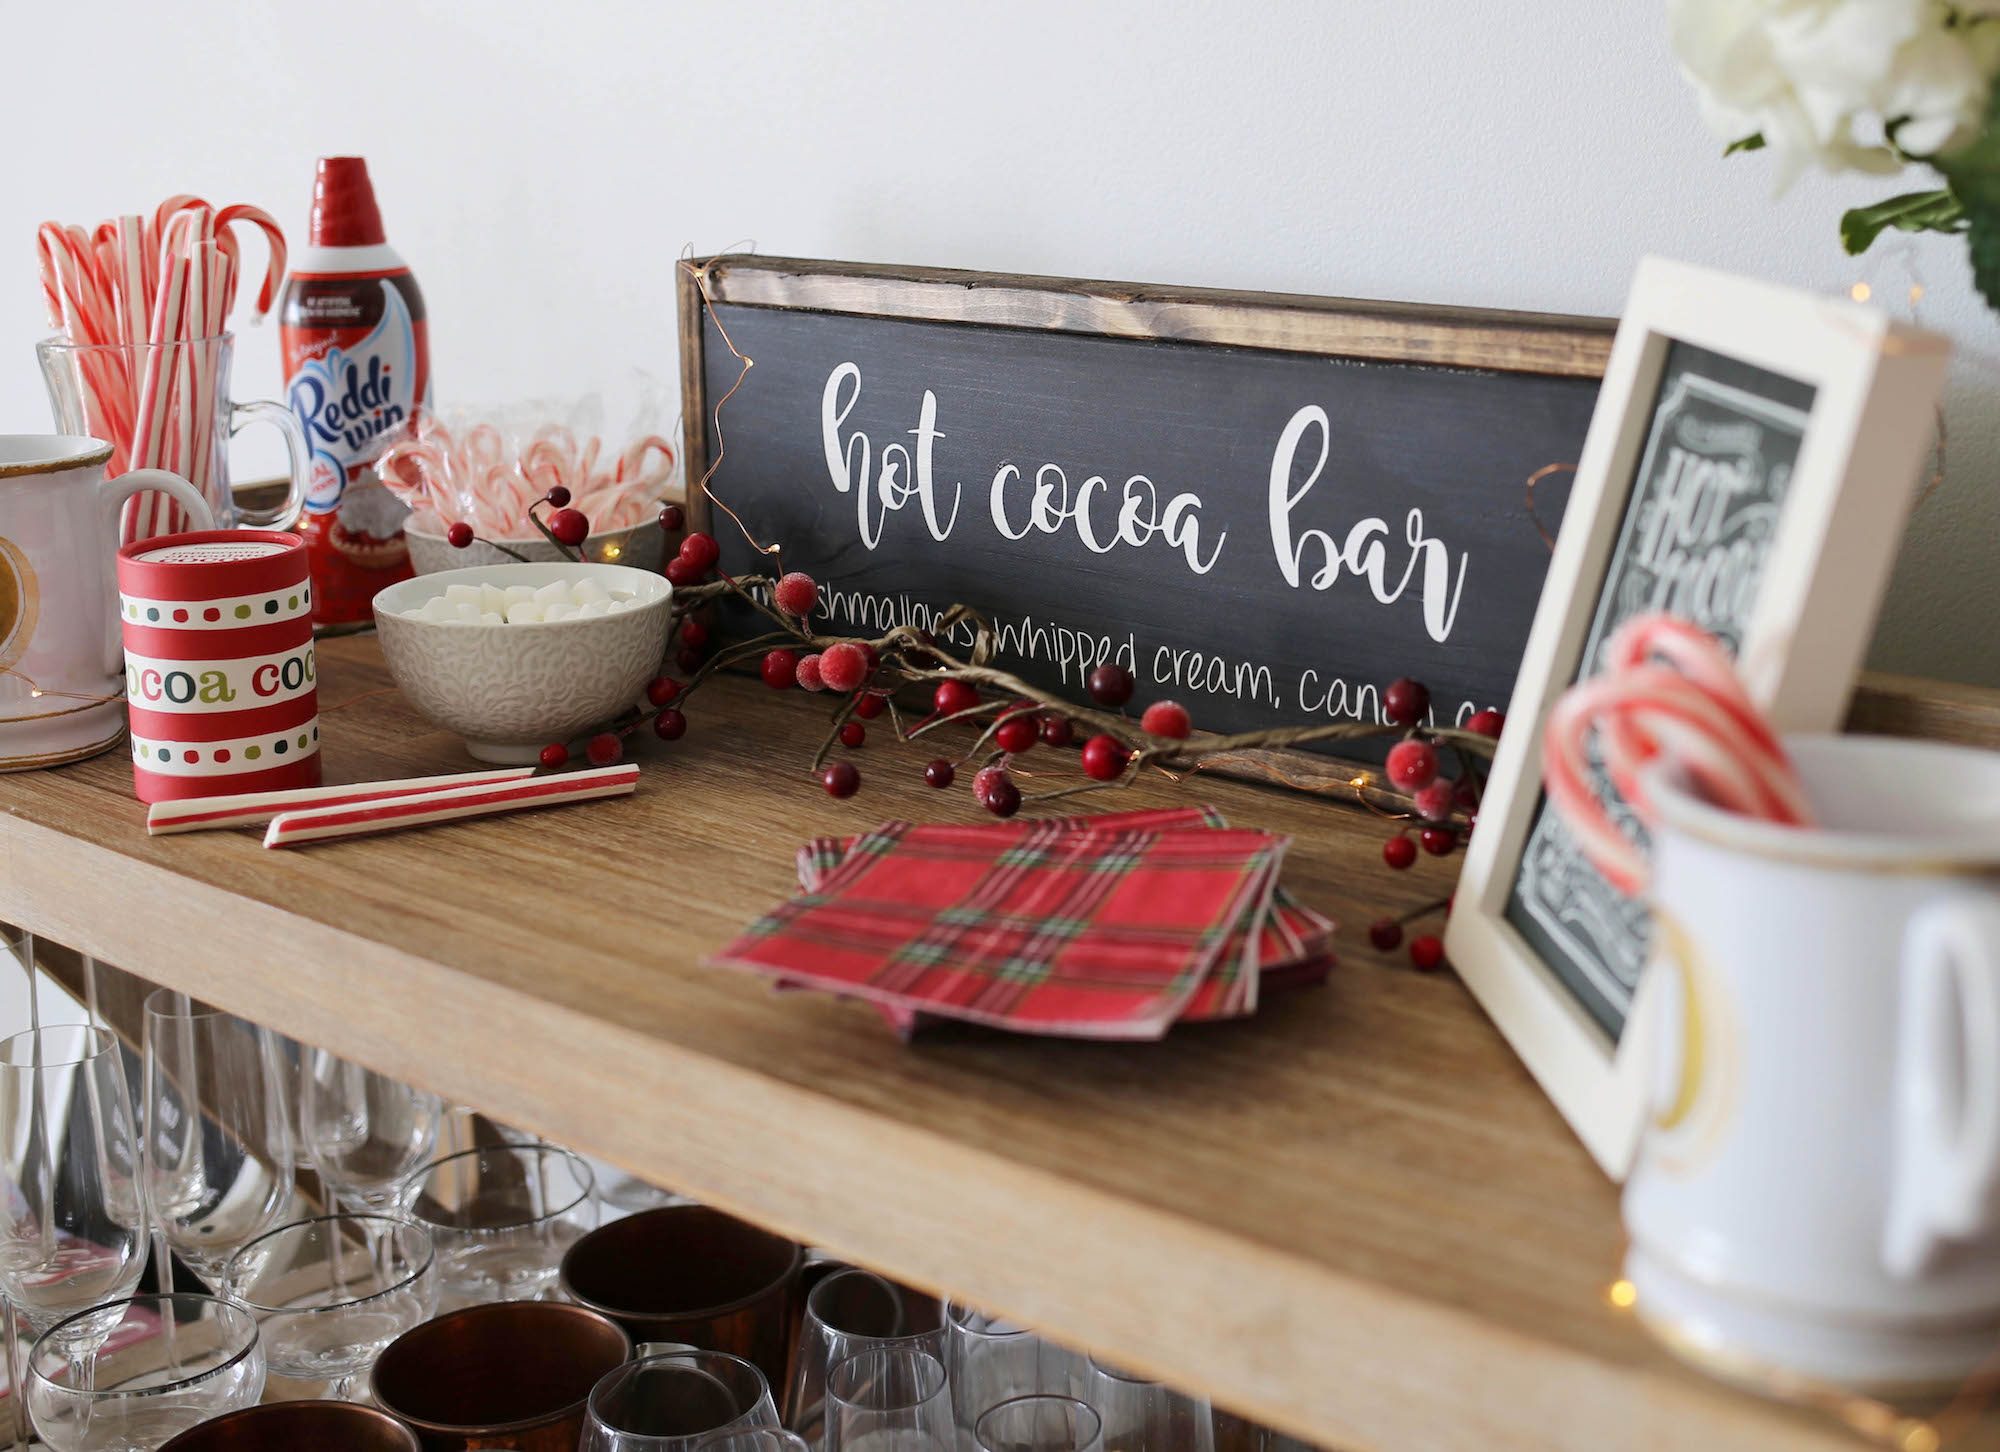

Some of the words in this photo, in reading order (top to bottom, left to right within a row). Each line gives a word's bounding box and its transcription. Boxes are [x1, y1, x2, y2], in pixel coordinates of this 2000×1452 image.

[290, 355, 391, 460] Reddi
[821, 361, 961, 551] hot
[989, 462, 1227, 575] cocoa
[1268, 404, 1469, 643] bar
[752, 574, 975, 647] mshmallows
[993, 615, 1137, 689] whipped
[1153, 645, 1280, 709] cream,
[1299, 669, 1435, 745] can
